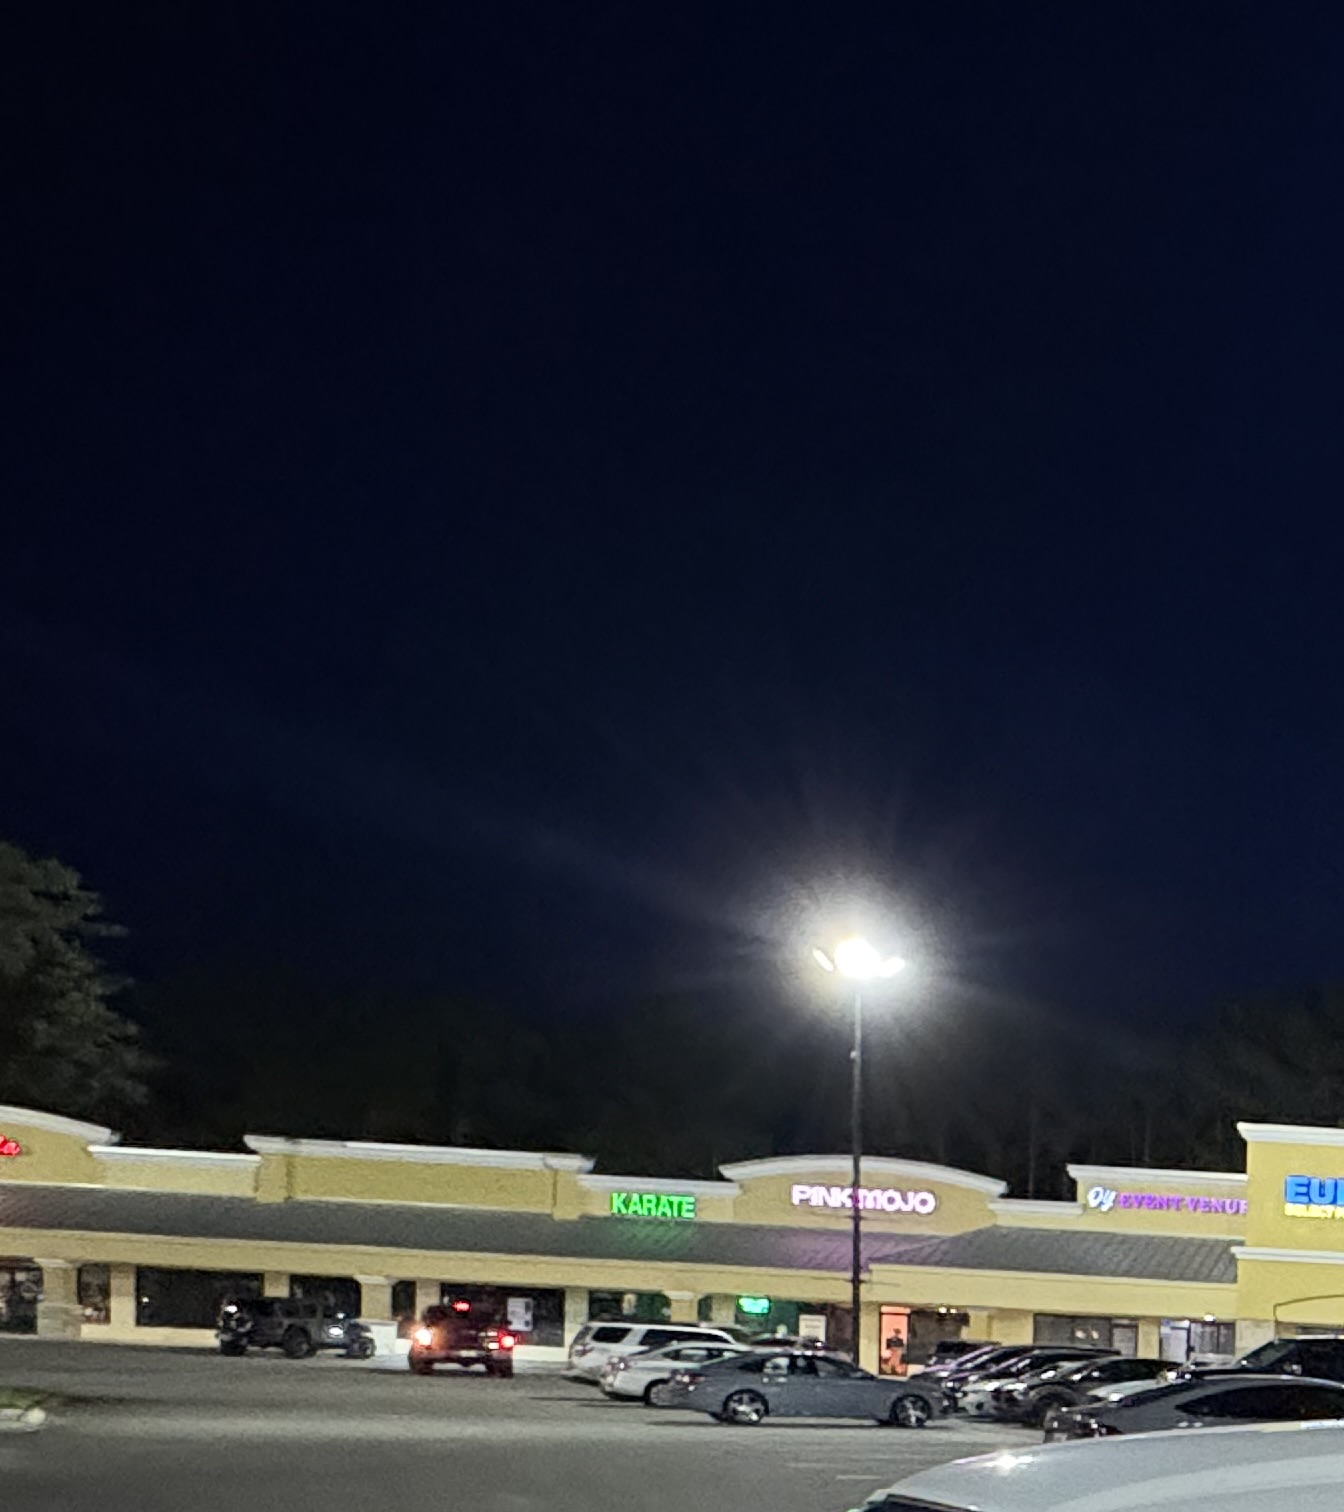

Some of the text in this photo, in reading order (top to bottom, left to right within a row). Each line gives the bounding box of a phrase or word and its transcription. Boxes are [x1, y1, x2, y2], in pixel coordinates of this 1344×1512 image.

[611, 1192, 696, 1219] KARATE
[791, 1184, 937, 1215] PINK MOJO
[1119, 1192, 1182, 1211] EVENT
